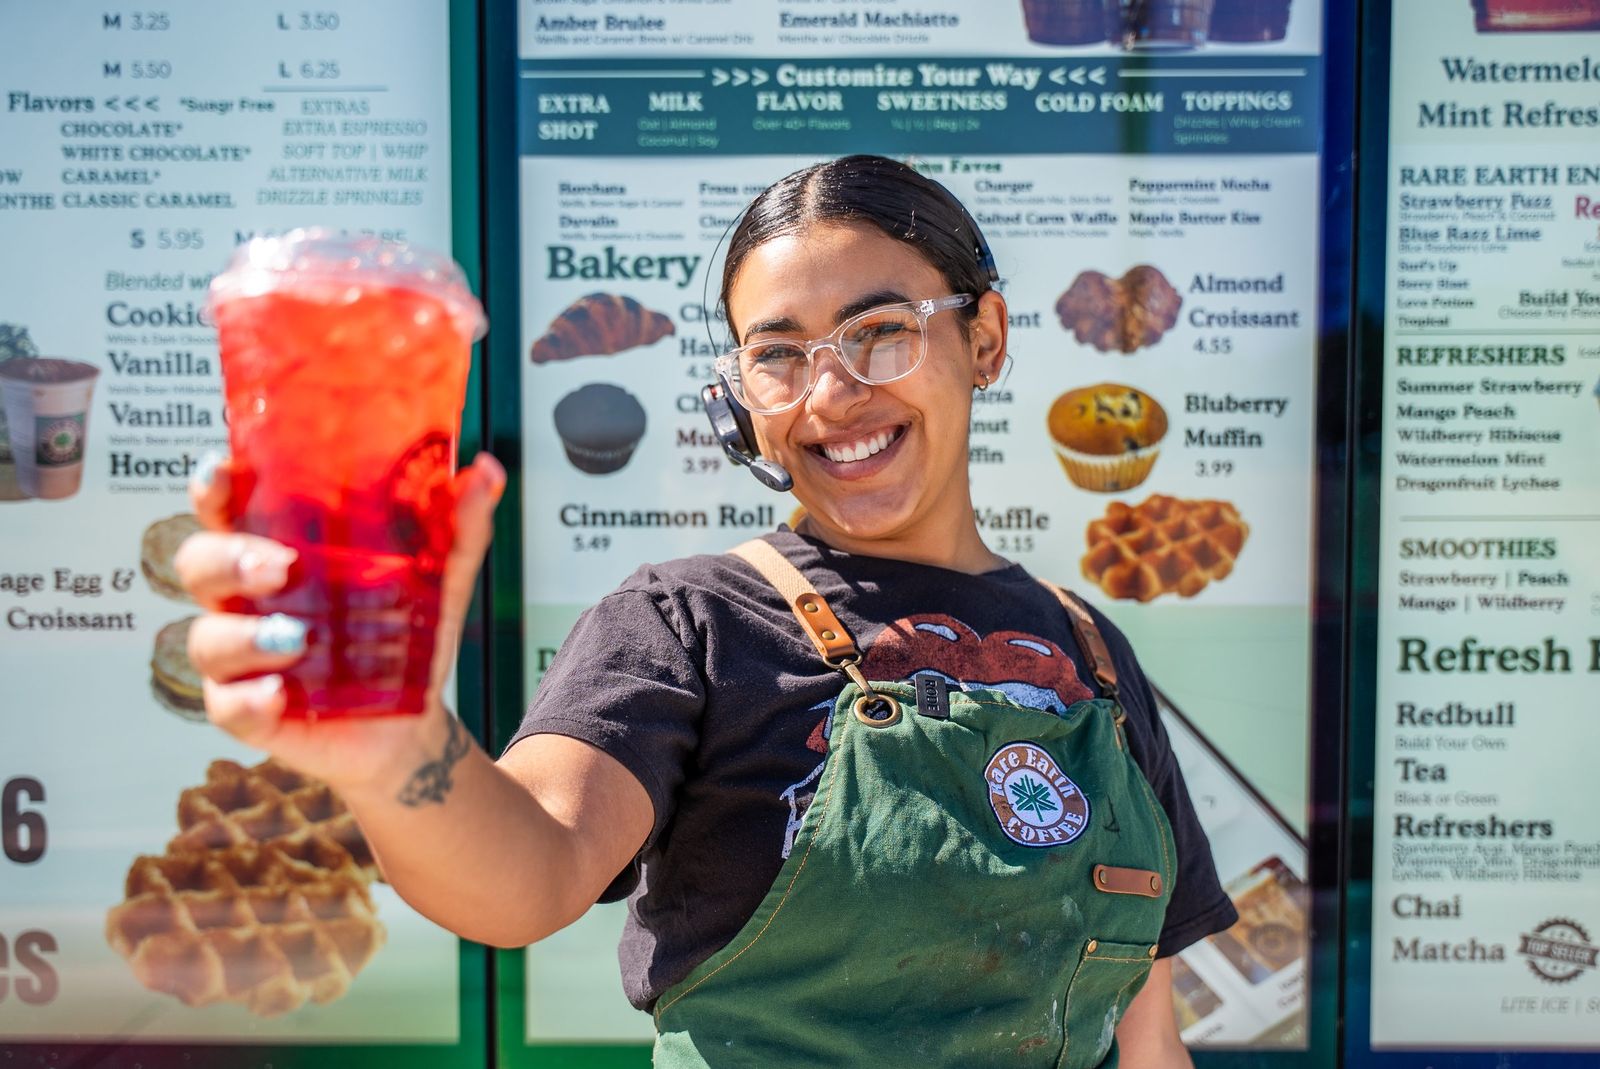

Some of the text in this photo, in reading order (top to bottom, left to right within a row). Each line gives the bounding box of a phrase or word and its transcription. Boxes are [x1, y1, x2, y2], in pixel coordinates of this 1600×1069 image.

[103, 12, 170, 31] M 3.25
[276, 12, 341, 31] L 3.50
[535, 16, 666, 31] Amber Brulee
[779, 12, 961, 29] Emerald Machiatto
[103, 60, 173, 79] M 5.50
[278, 60, 341, 79] L 6.25
[777, 63, 1042, 91] Customize Your Way
[7, 91, 96, 113] Flavors
[239, 97, 276, 112] Free
[301, 99, 370, 116] EXTRAS
[538, 93, 612, 114] EXTRA
[649, 91, 704, 112] MILK
[756, 91, 845, 112] FLAVOR
[876, 91, 1009, 112] SWEETNESS
[1035, 92, 1165, 113] COLD FOAM
[1181, 91, 1294, 112] TOPPINGS
[808, 117, 852, 131] Flavors
[1418, 101, 1600, 128] Mint Refres
[282, 120, 428, 137] EXTRA ESPRESSO
[538, 120, 599, 141] SHOT
[638, 133, 690, 148] Coconut
[61, 145, 124, 162] WHITE
[282, 143, 429, 160] SOFT TOP WHIP
[267, 166, 428, 183] ALTERNATIVE MILK
[1400, 166, 1467, 186] RARE
[1474, 166, 1558, 186] EARTH
[1129, 178, 1272, 194] Peppermint Mocha
[61, 192, 141, 209] CLASSIC
[145, 192, 237, 209] CARAMEL
[256, 189, 424, 206] DRIZZLE SPRINKLES
[1400, 193, 1504, 212] Strawberry
[1129, 211, 1174, 227] Maple
[129, 229, 204, 250] S 5.95
[1400, 226, 1441, 242] Blue
[1495, 226, 1542, 242] Lime
[546, 245, 702, 290] Bakery
[106, 270, 184, 291] Blended
[1188, 272, 1284, 294] Almond
[1518, 289, 1568, 307] Build
[1188, 307, 1301, 329] Croissant
[1193, 336, 1233, 355] 4.55
[1396, 344, 1566, 368] REFRESHERS
[108, 351, 211, 377] Vanilla
[1397, 377, 1584, 399] Summer Strawberry
[109, 402, 213, 427] Vanilla
[1184, 393, 1290, 418] Bluberry
[1397, 405, 1517, 422] Mango Peach
[1184, 427, 1264, 448] Muffin
[1398, 429, 1562, 447] Wildberry Hibiscus
[1195, 459, 1234, 478] 3.99
[1396, 453, 1547, 468] Watermelon Mint
[1396, 477, 1561, 495] Dragonfruit Lychee
[560, 504, 777, 528] Cinnamon Roll
[1400, 538, 1557, 560] SMOOTHIES
[54, 567, 103, 596] Egg
[112, 568, 135, 592] &
[1400, 572, 1569, 590] Strawberry Peach
[1400, 595, 1566, 614] Mango Wildberry
[7, 607, 136, 632] Croissant
[1397, 636, 1573, 674] Refresh
[1396, 701, 1515, 728] Redbull
[1395, 736, 1506, 751] Build Your Own
[1024, 748, 1076, 799] Earth
[1394, 757, 1448, 783] Tea
[1394, 791, 1498, 806] Black or Green
[1, 775, 48, 866] 6
[1006, 811, 1084, 842] COFFEE
[1393, 814, 1554, 839] Refreshers
[1392, 894, 1463, 920] Chai
[1392, 936, 1507, 963] Matcha
[1501, 996, 1538, 1014] LITE
[1541, 996, 1570, 1014] ICE
